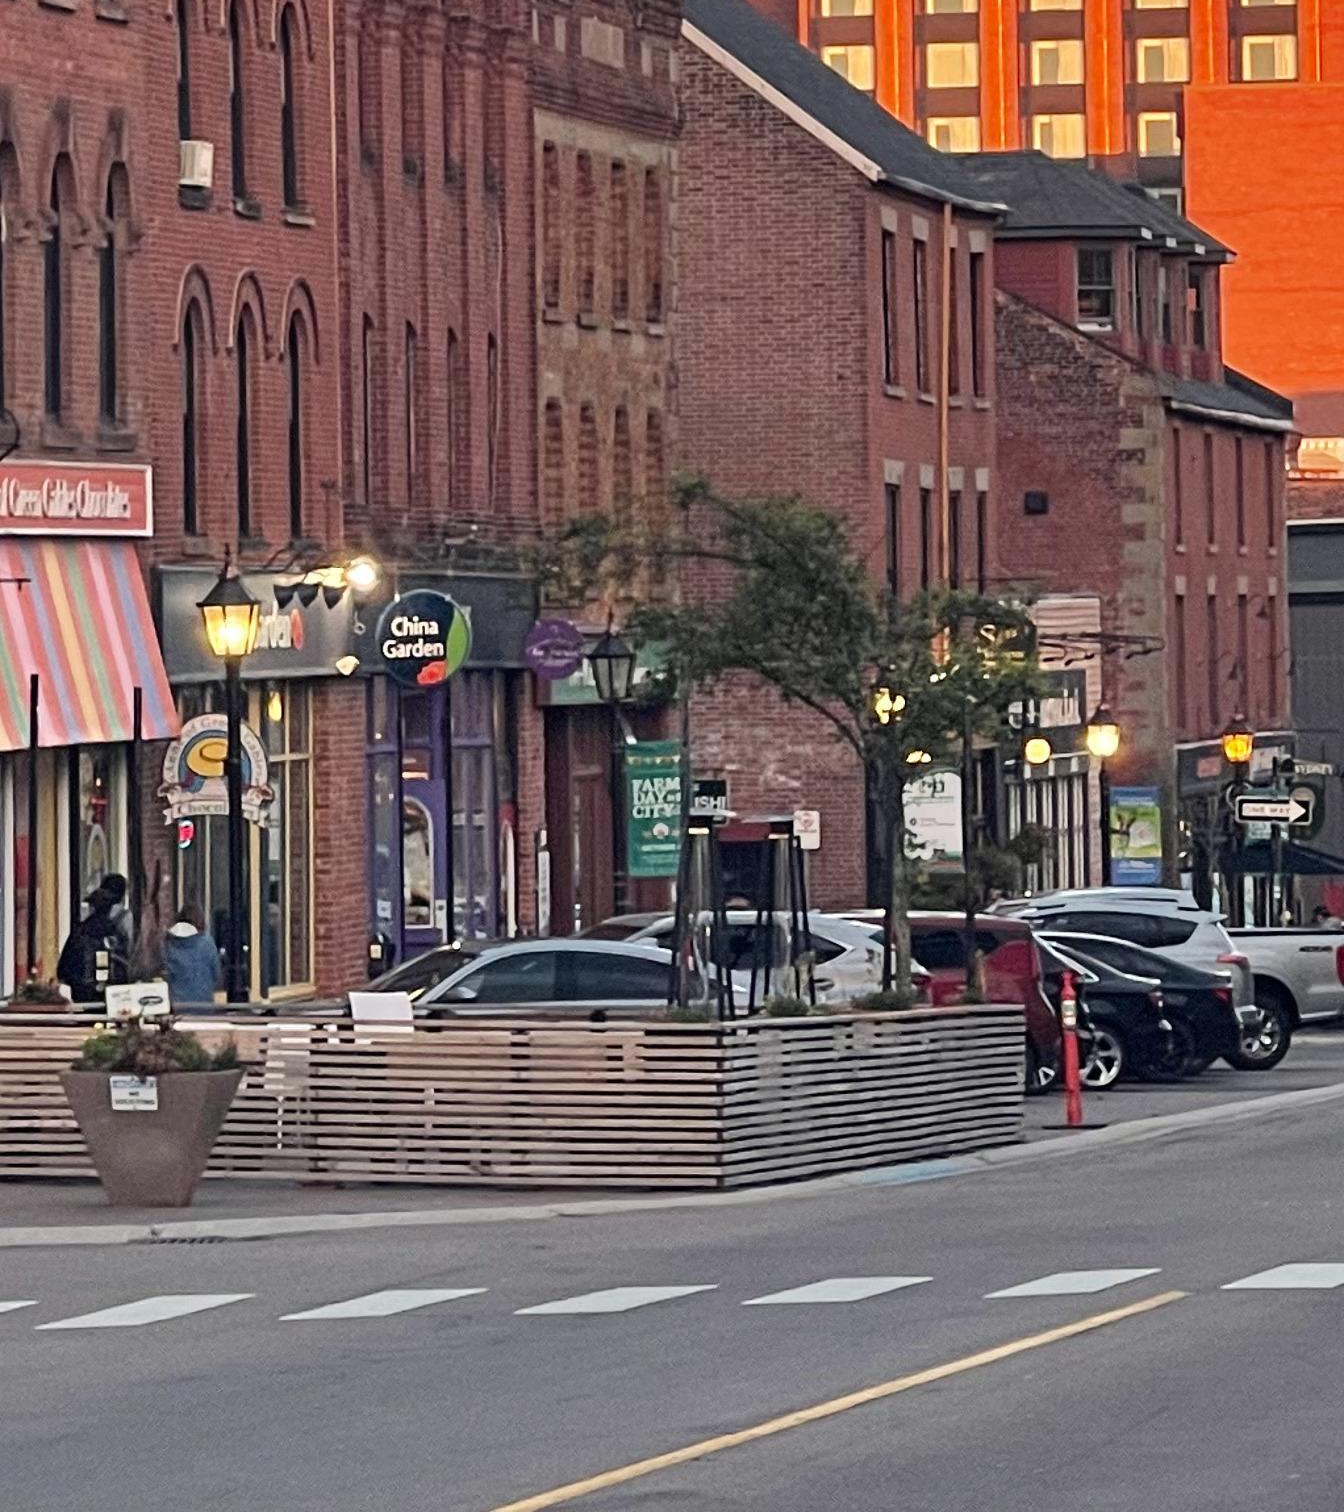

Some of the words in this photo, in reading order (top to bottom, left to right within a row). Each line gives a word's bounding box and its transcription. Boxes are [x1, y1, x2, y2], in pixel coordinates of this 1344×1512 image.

[390, 615, 439, 637] China
[382, 638, 445, 660] Garden
[632, 777, 681, 792] FARM
